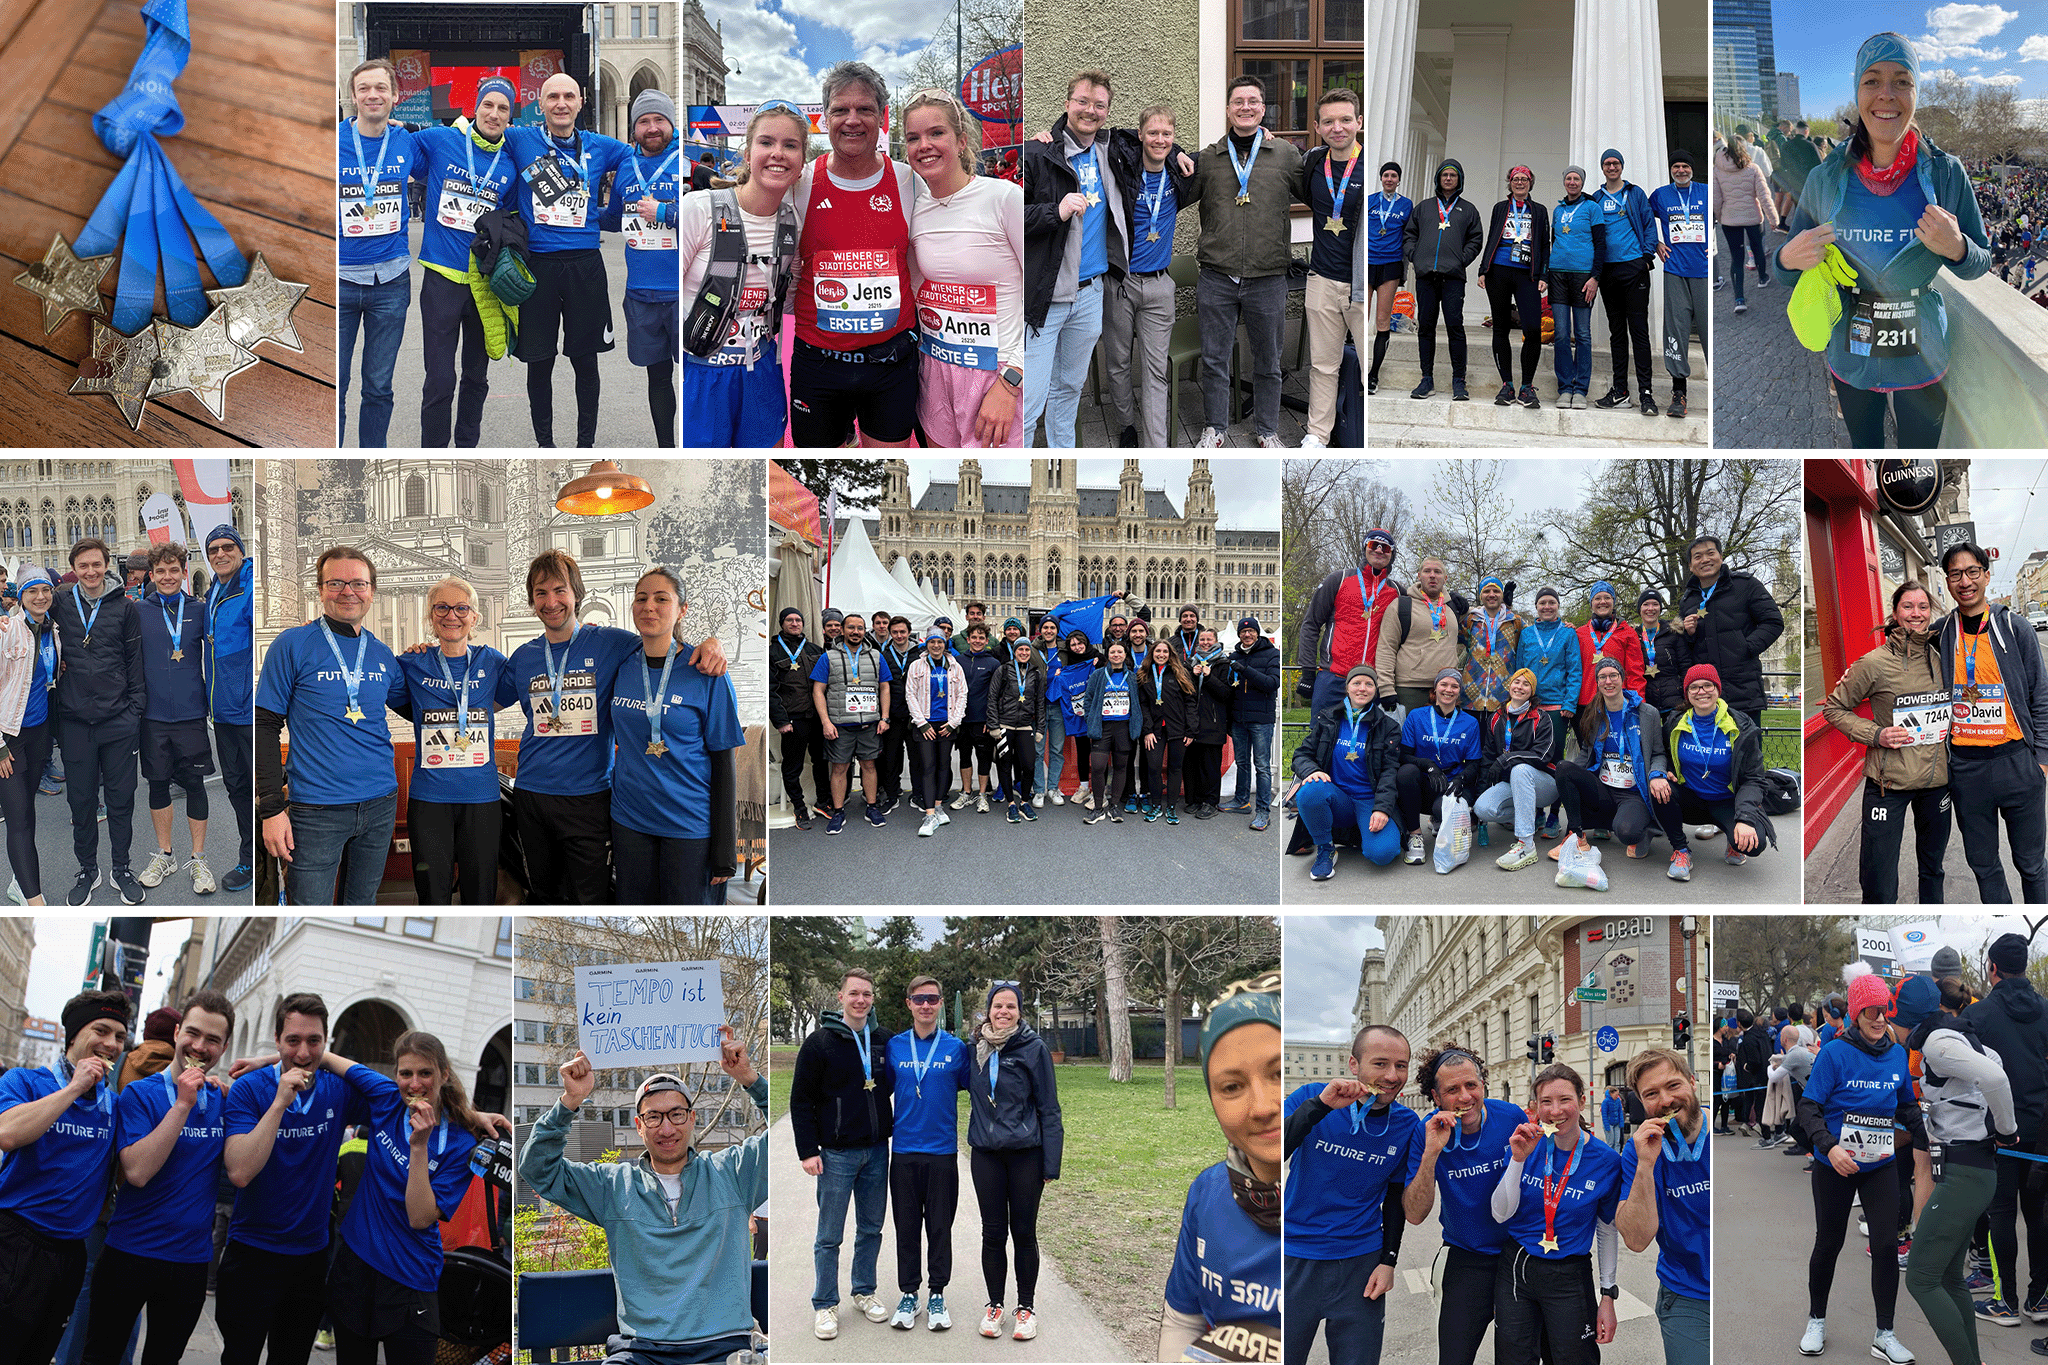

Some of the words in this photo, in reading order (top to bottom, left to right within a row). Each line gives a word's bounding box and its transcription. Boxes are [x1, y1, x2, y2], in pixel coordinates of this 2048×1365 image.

[399, 89, 430, 97] atulation
[520, 90, 541, 100] Fol
[981, 99, 1020, 113] SPORS
[387, 165, 401, 174] FIT
[342, 184, 400, 197] POWRADE
[537, 180, 555, 198] 497
[659, 182, 673, 191] FIT
[1835, 228, 1894, 242] FUTURE
[1899, 229, 1914, 241] FI
[833, 251, 873, 262] WIENER
[818, 283, 846, 299] Hervis
[852, 283, 892, 301] Jens
[930, 282, 966, 295] WIENER
[1873, 309, 1891, 319] MAKE
[829, 317, 869, 331] ERSTE
[944, 315, 991, 336] Anna
[1876, 327, 1917, 347] 2311
[202, 341, 229, 355] VCM
[930, 343, 962, 365] ERSTE
[1883, 465, 1934, 485] GUINNESS
[317, 671, 366, 682] FUTE
[368, 671, 383, 682] FIT
[421, 677, 462, 690] FUTUE
[531, 676, 593, 691] POWRADE
[560, 696, 593, 711] 864D
[1896, 691, 1950, 706] POWERADE
[424, 711, 486, 722] POWEADE
[1924, 708, 1950, 725] 724A
[1971, 705, 2002, 718] David
[1713, 747, 1727, 756] FIT
[1871, 806, 1888, 821] CR
[1862, 938, 1893, 953] 2001
[587, 978, 674, 1007] TEMPO
[682, 978, 706, 1003] ist
[1717, 988, 1738, 997] 2000
[582, 1002, 622, 1027] kein
[589, 1023, 721, 1054] TASCHENTUCH
[899, 1061, 930, 1069] FUTR
[933, 1061, 946, 1069] FIT
[1845, 1080, 1881, 1090] FUTURE
[1883, 1081, 1896, 1090] FIT
[1845, 1113, 1893, 1128] POWERADE
[180, 1126, 208, 1138] TURE
[211, 1127, 224, 1138] FIT
[276, 1126, 315, 1139] FUTURE
[1866, 1133, 1893, 1146] 2311C
[1315, 1139, 1367, 1162] FUTURE
[1368, 1153, 1387, 1166] FIT
[492, 1162, 513, 1183] 190
[1447, 1162, 1491, 1180] FUTURE
[1564, 1186, 1585, 1200] FIT
[1666, 1180, 1710, 1199] FUTURE
